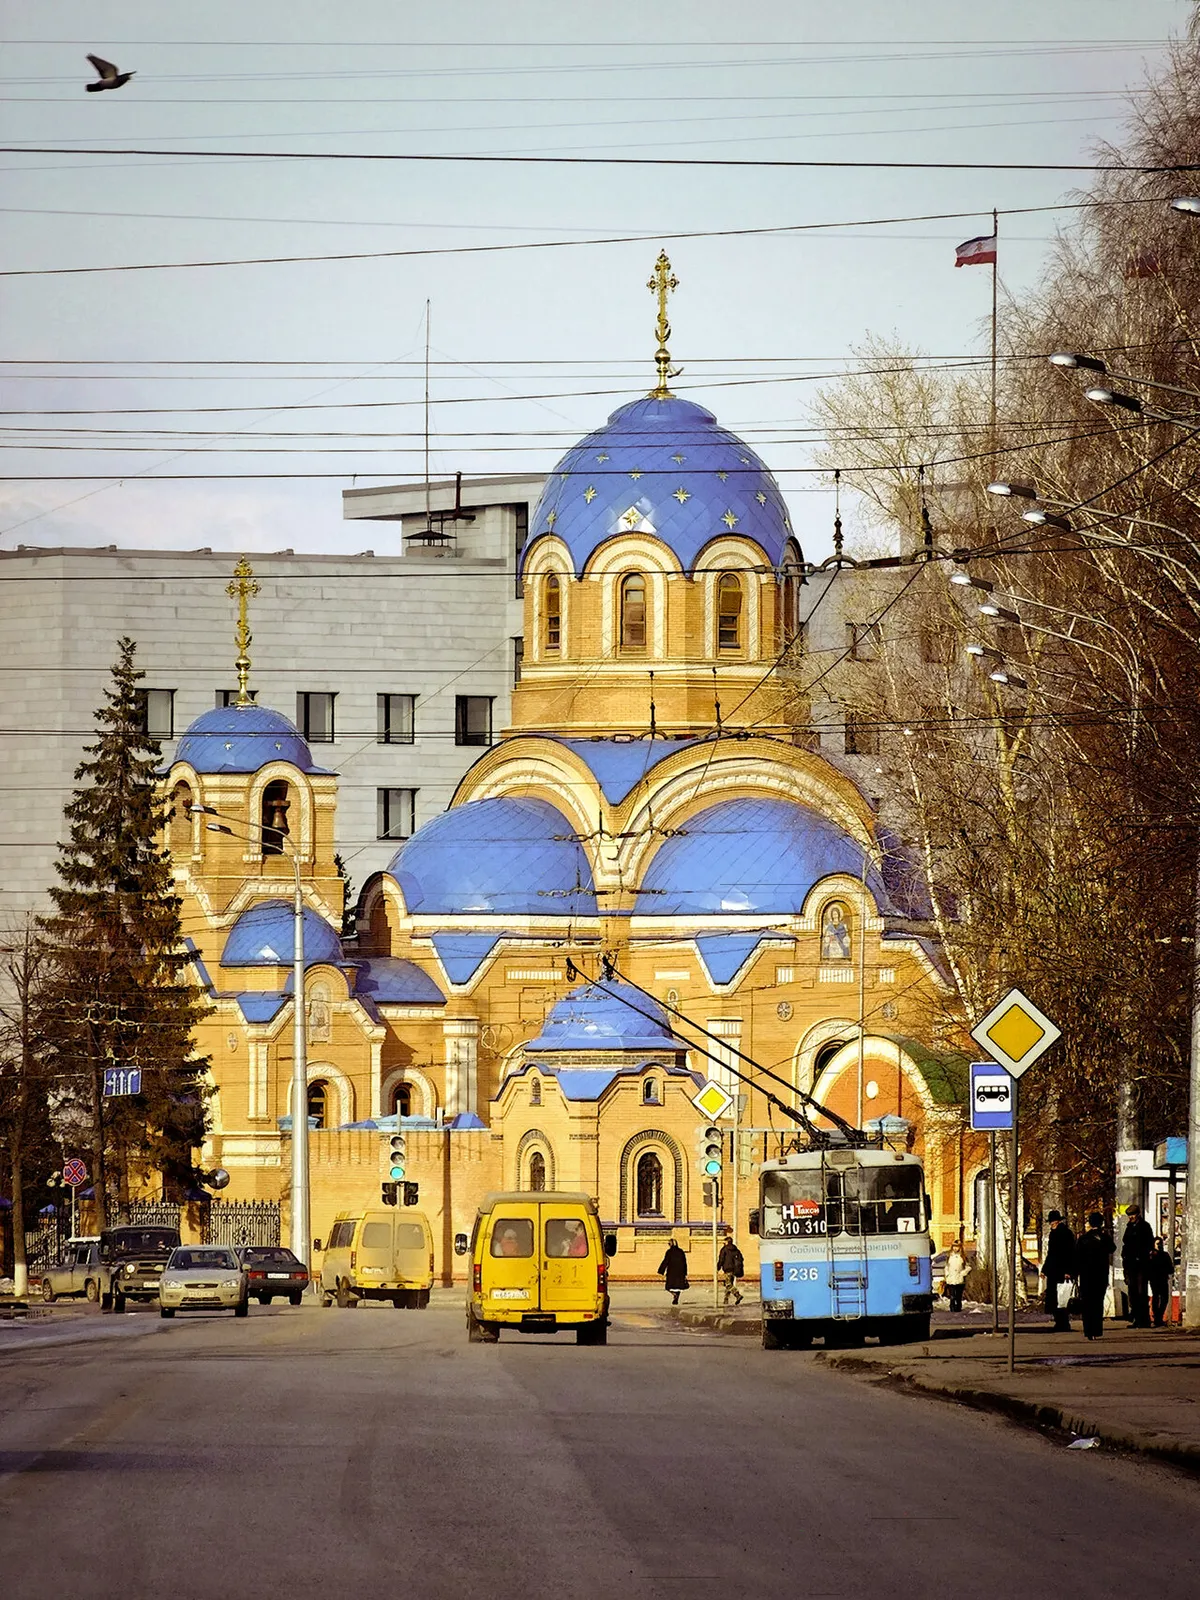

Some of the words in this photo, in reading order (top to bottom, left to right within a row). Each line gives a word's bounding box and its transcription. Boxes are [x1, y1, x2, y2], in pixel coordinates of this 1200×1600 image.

[795, 1204, 819, 1215] Такси
[779, 1221, 800, 1235] 310
[805, 1220, 827, 1234] 310
[903, 1220, 910, 1231] 7
[789, 1268, 819, 1282] 236
